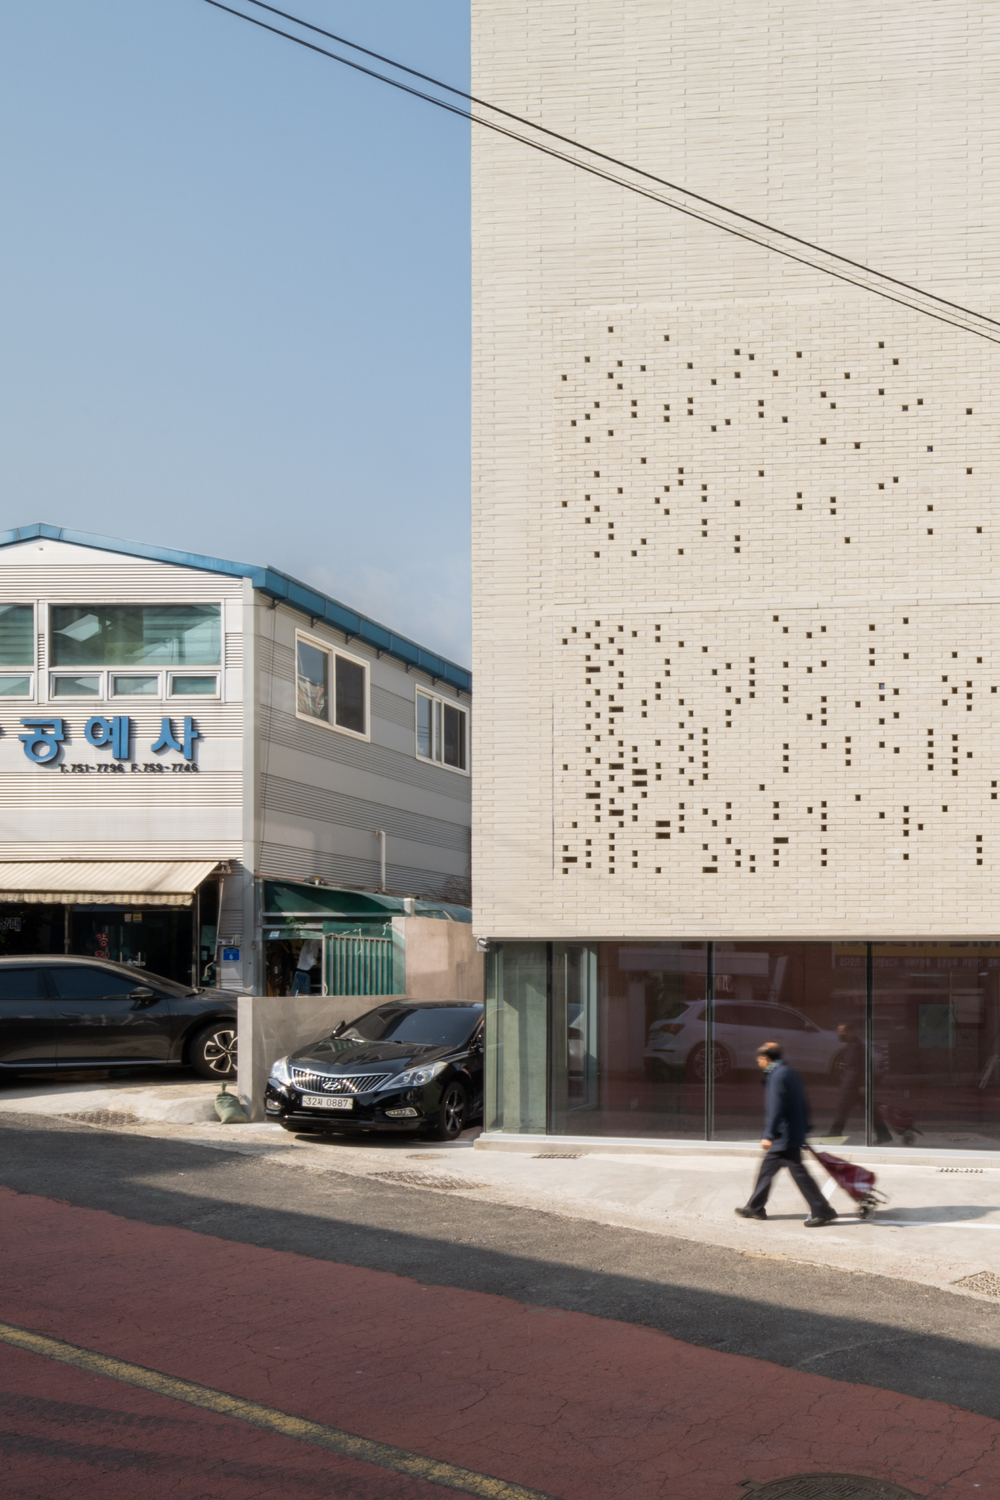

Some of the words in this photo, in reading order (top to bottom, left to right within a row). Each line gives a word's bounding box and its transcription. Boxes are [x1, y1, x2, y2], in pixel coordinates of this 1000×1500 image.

[58, 763, 124, 773] T.751-7796
[131, 763, 199, 773] F.759-7746
[326, 1098, 348, 1107] 0887
